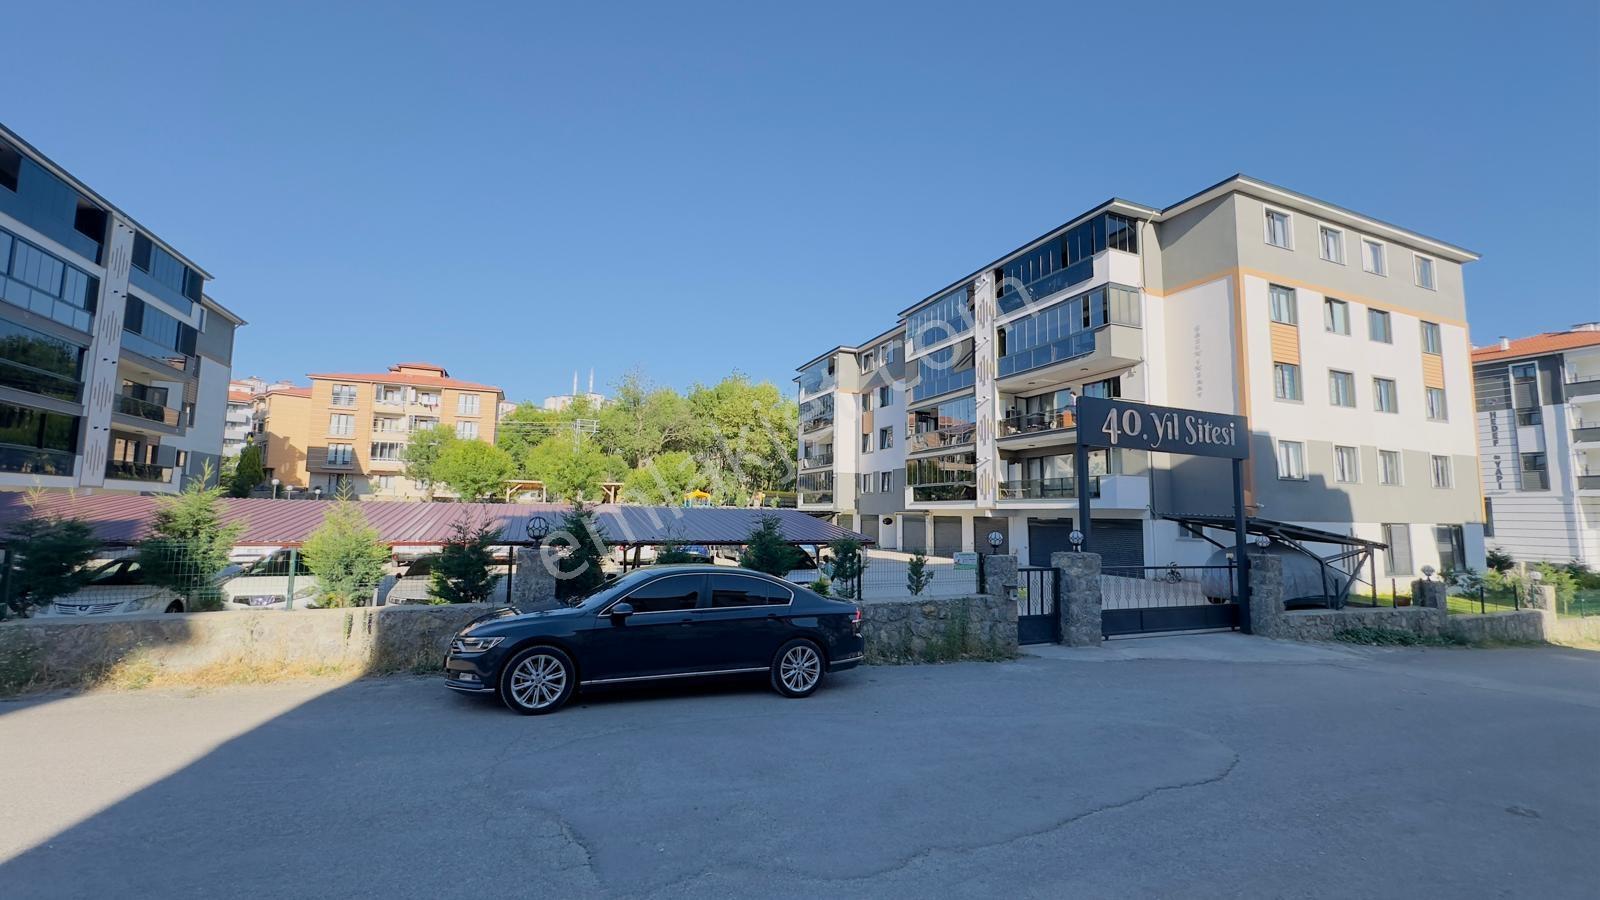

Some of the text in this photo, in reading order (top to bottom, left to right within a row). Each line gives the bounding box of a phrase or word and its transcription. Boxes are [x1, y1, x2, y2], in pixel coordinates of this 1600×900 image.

[1101, 407, 1148, 445] 40.
[1185, 415, 1236, 446] Sitesi
[1489, 411, 1499, 447] HEDEF
